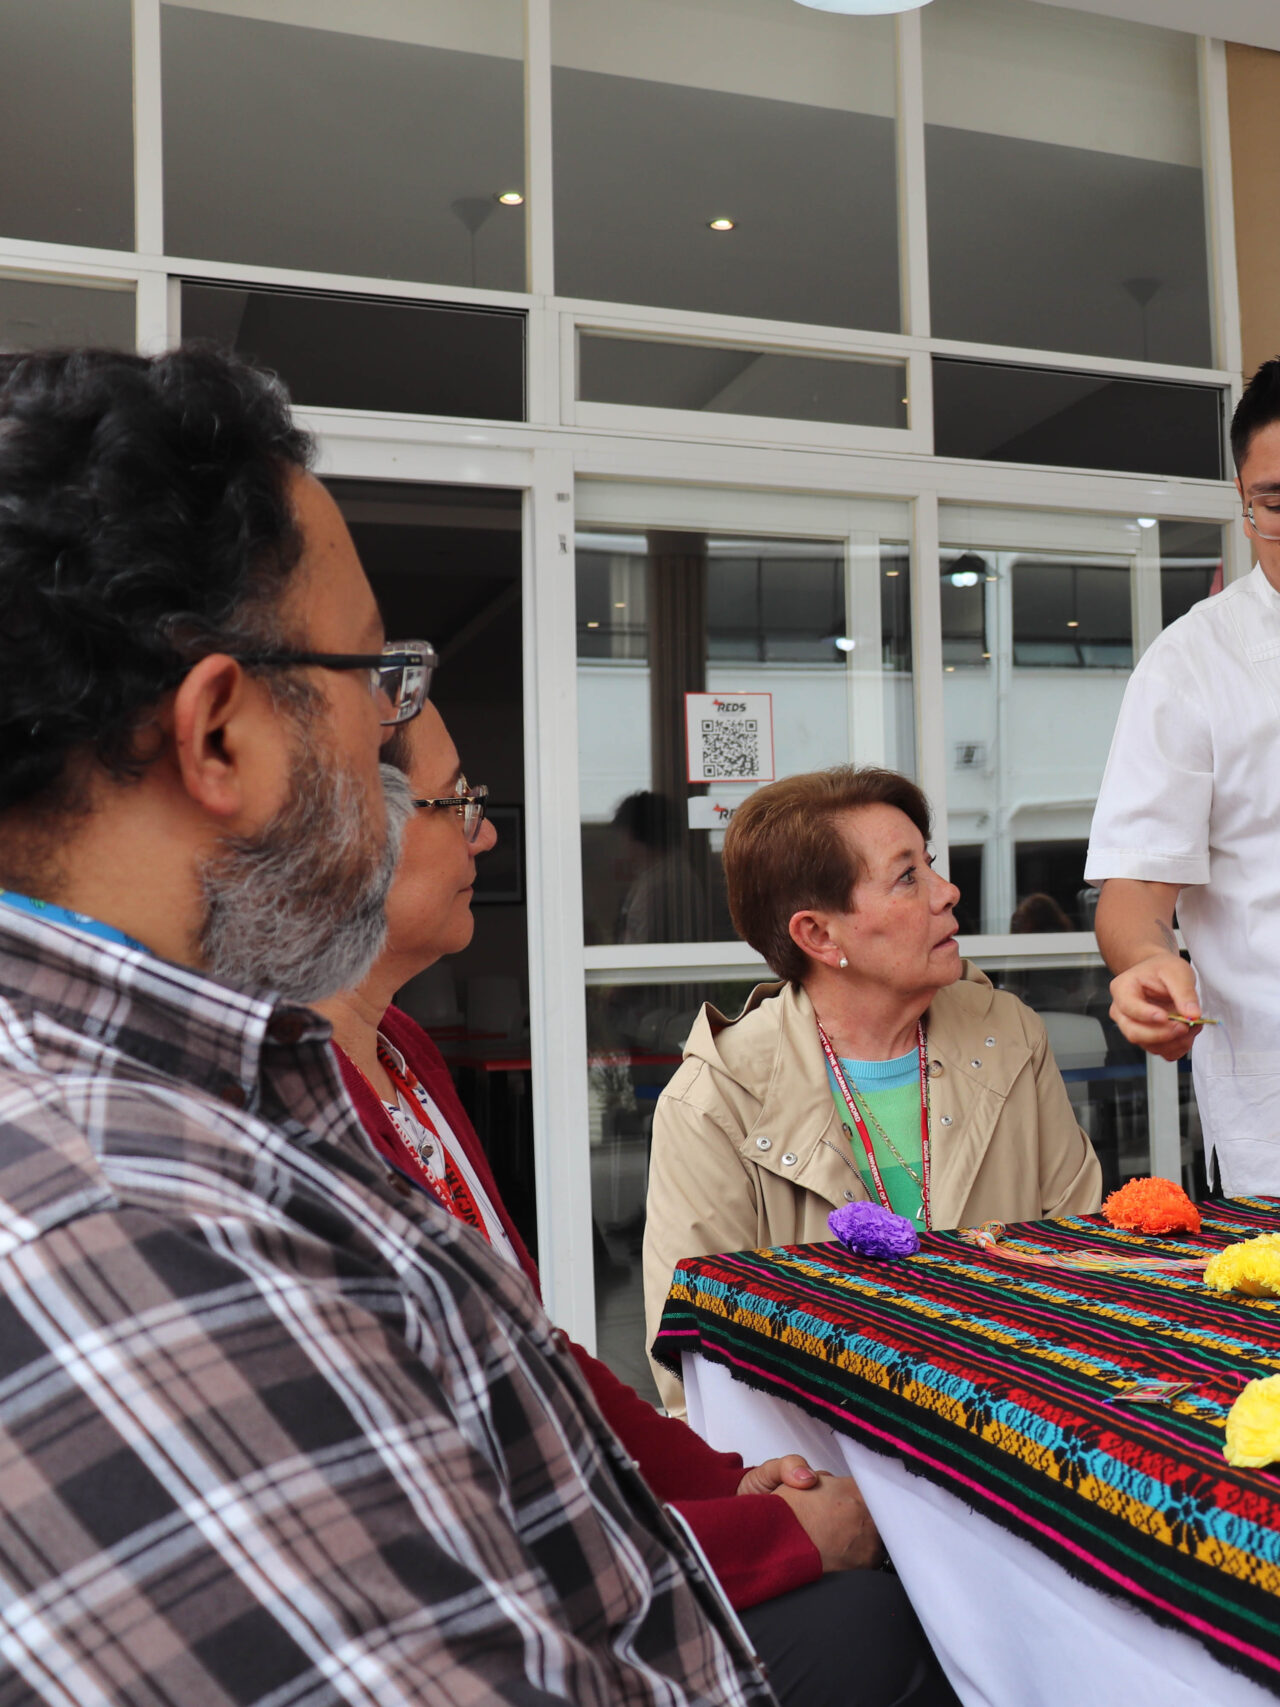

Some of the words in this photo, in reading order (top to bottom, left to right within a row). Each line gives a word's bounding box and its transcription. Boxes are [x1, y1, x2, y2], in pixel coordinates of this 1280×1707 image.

[717, 703, 746, 712] REDS
[824, 1044, 831, 1053] OF
[828, 1052, 838, 1066] THE
[833, 1065, 852, 1102] INCARNATE
[848, 1100, 861, 1123] WORD
[867, 1151, 884, 1191] UNIVERSITY
[880, 1191, 887, 1201] OF
